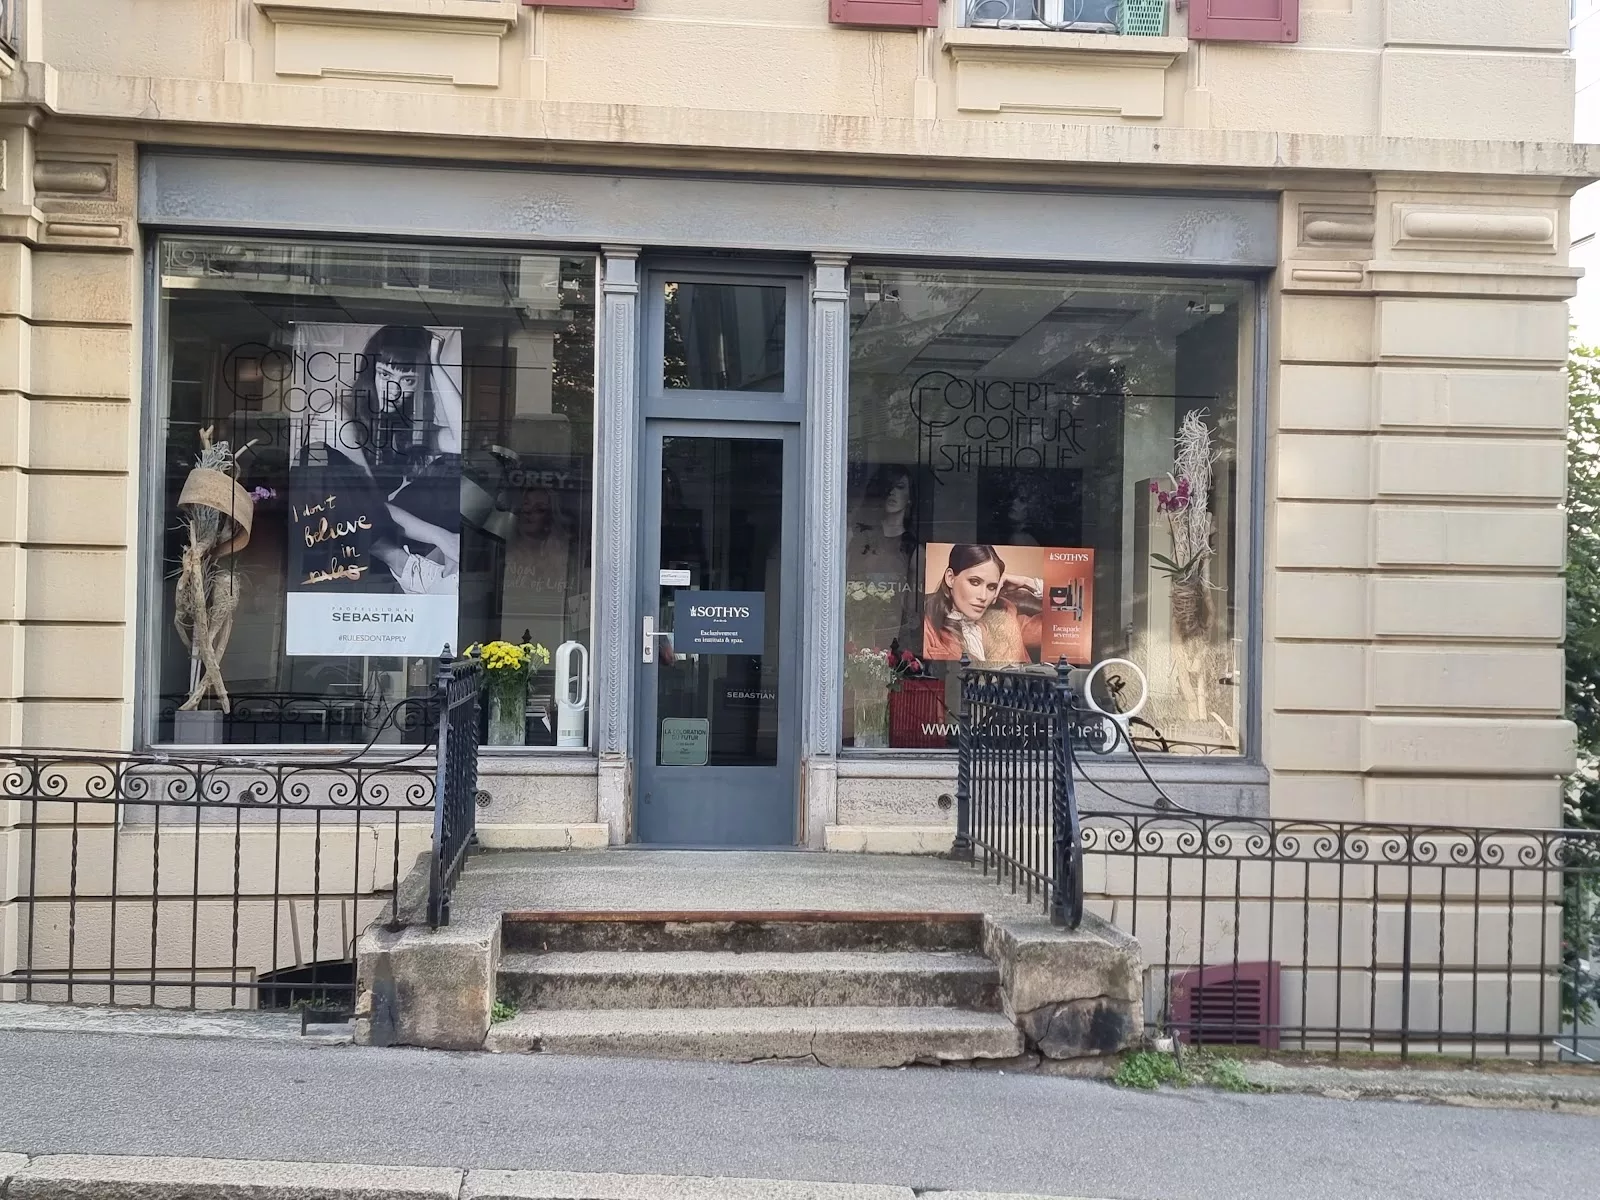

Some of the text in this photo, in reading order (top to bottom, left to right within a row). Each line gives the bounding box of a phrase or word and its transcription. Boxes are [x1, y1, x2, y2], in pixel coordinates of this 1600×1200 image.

[223, 342, 382, 400] CONCEPT
[910, 371, 1055, 427] CONCEPT
[964, 410, 1086, 454] COIFFURE
[303, 494, 337, 517] don't
[304, 514, 372, 547] believe
[341, 543, 361, 559] in
[1054, 552, 1089, 562] SOTHYS
[332, 612, 414, 623] SEBASTIAN
[697, 606, 750, 618] SOTHYS
[338, 634, 407, 643] #RULESDONTAPPLY
[726, 691, 776, 699] SEBASTIAN
